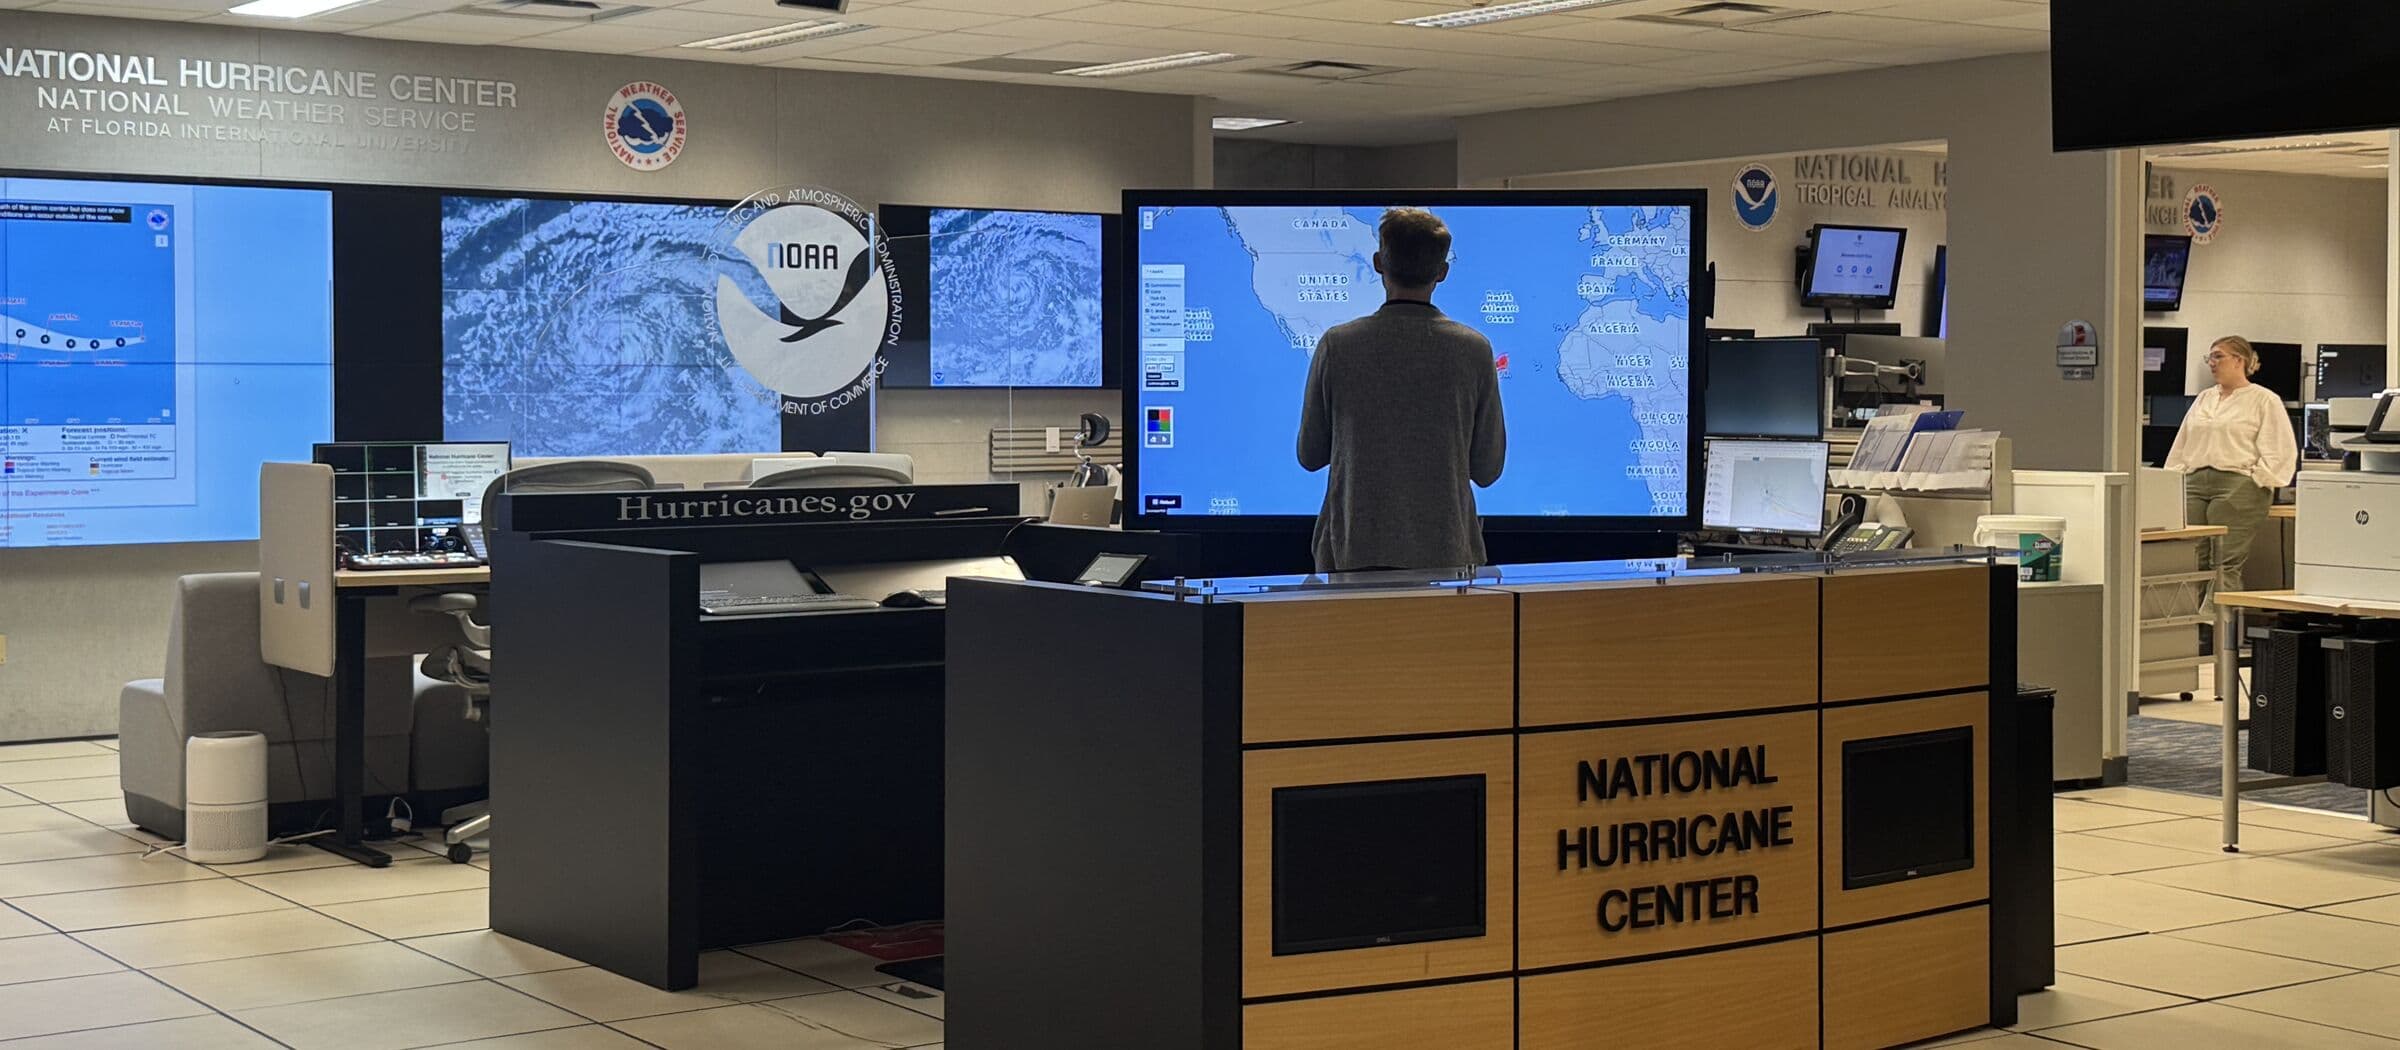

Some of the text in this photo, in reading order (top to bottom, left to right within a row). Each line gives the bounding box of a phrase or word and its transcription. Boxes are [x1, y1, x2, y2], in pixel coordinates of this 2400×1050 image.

[0, 47, 517, 108] NATIONAL HURRICANE CENTER
[38, 86, 476, 132] NATIONAL WEATHER SERVICE
[47, 117, 73, 133] AT
[81, 119, 172, 138] FLORIDA
[181, 123, 344, 148] INTERNATIONAL
[605, 83, 685, 165] NATIONAL WEATHER SERVICE
[1795, 154, 1912, 184] NATIONAL
[1795, 184, 1947, 211] TROPICAL ANALY
[1293, 220, 1348, 229] CANADA
[1608, 236, 1666, 246] GERMANY
[752, 193, 780, 213] AND
[787, 188, 871, 231] ATMOSPHERIC
[873, 234, 903, 346] ADMINISTRATION
[767, 242, 838, 270] NOAA
[1592, 258, 1638, 267] FRANCE
[1299, 276, 1349, 285] UNITED
[1578, 283, 1614, 294] SPAIN
[1299, 290, 1349, 301] STATES
[1590, 323, 1640, 334] ALGERIA
[810, 401, 829, 415] OF
[1631, 440, 1680, 452] ANGOLA
[1627, 467, 1679, 476] NAMIBIA
[616, 491, 916, 521] Hurricanes.gov
[1578, 745, 1778, 802] NATIONAL
[1557, 805, 1793, 871] HURRICANE
[1597, 874, 1759, 932] CENTER
